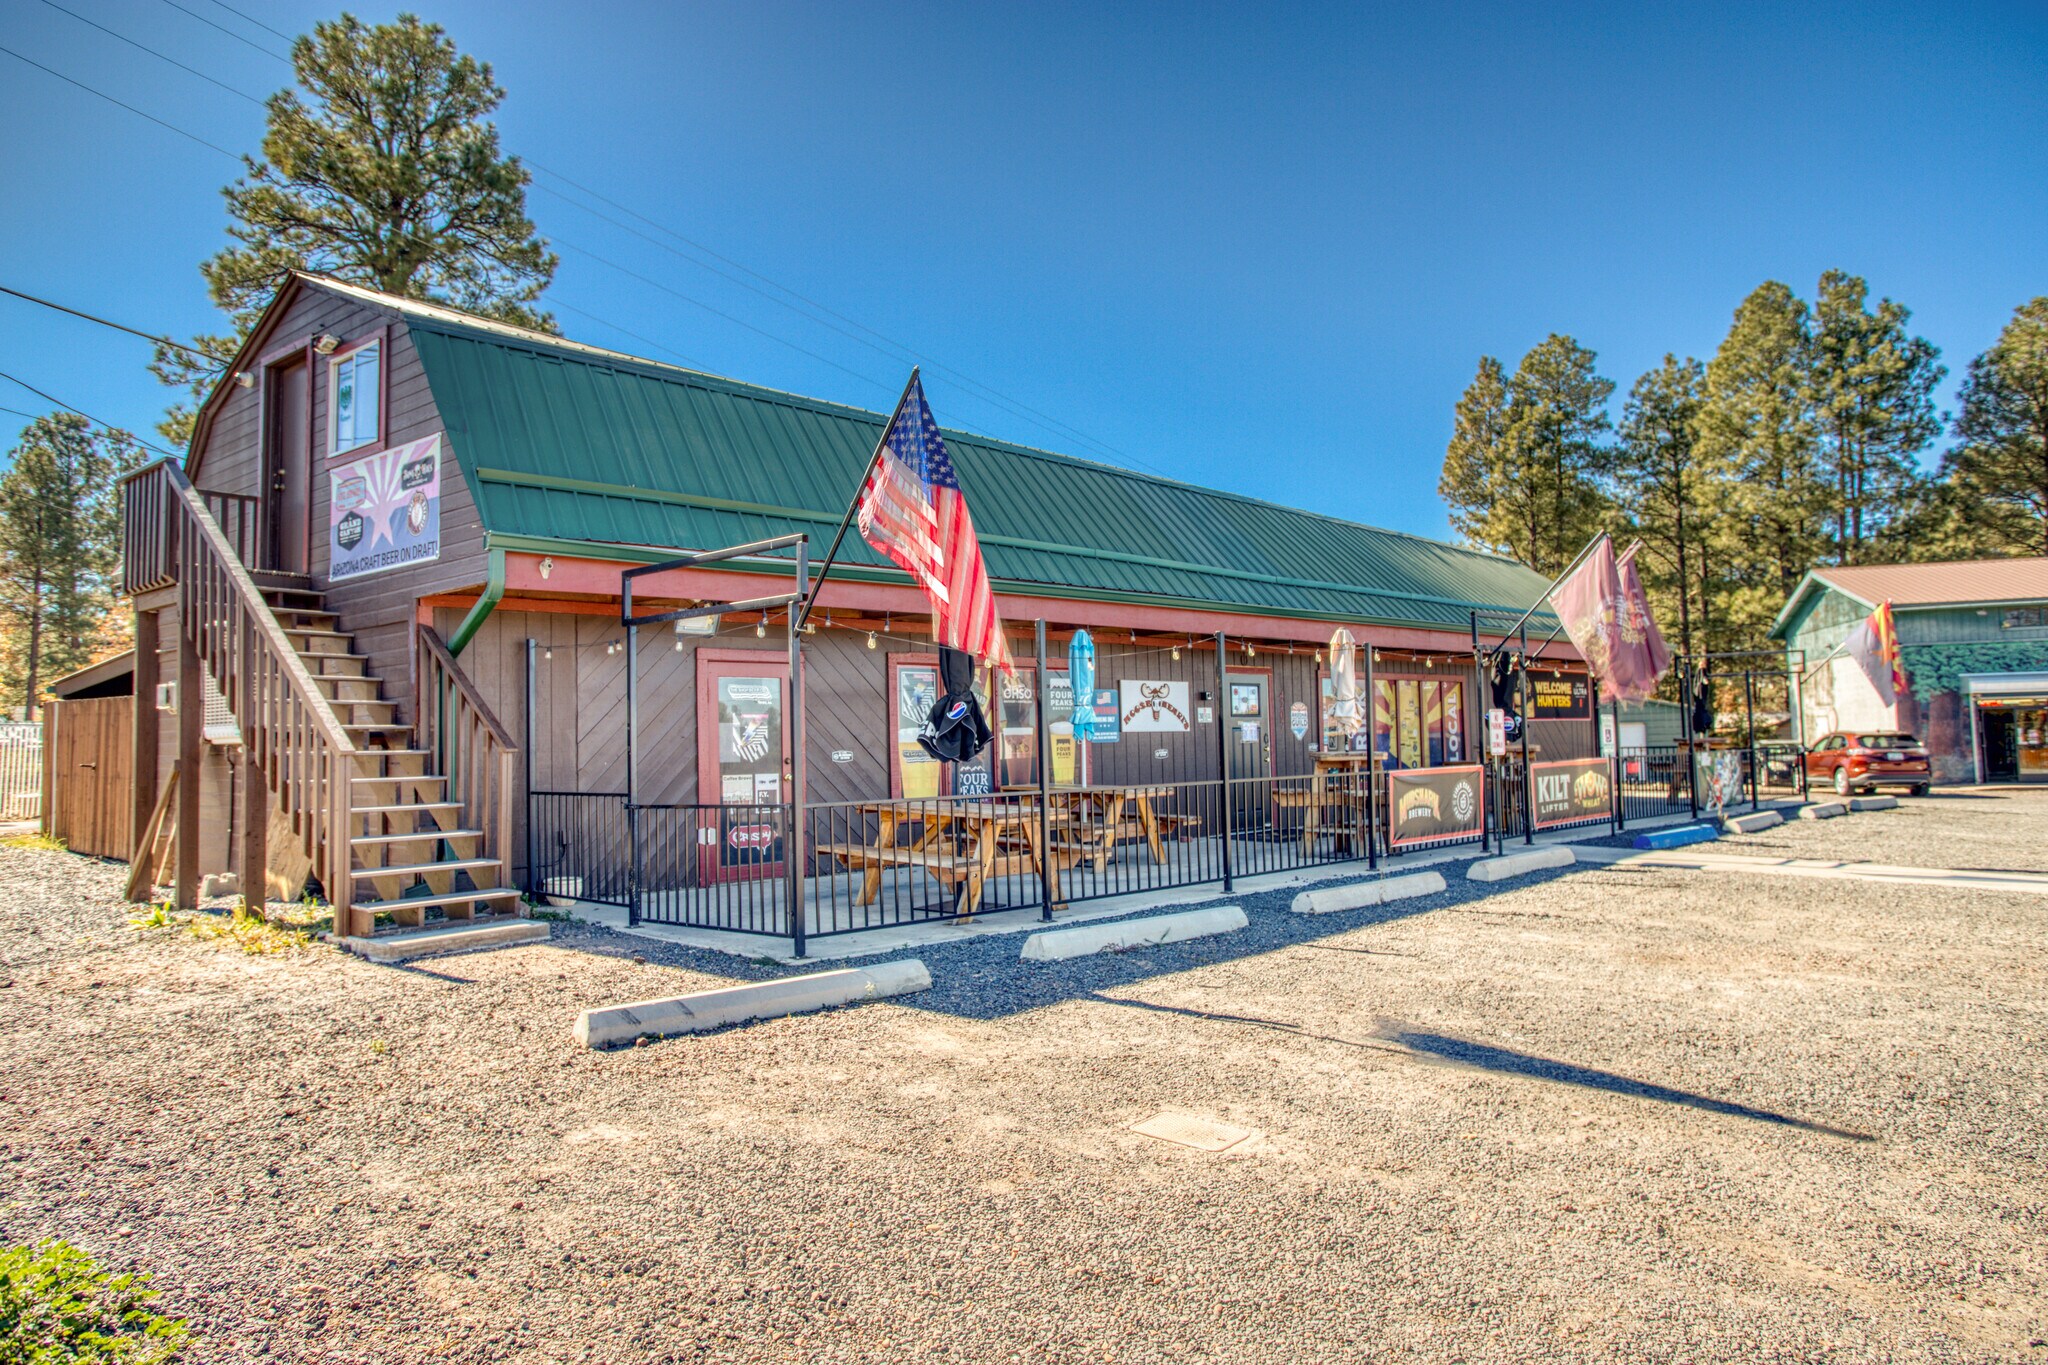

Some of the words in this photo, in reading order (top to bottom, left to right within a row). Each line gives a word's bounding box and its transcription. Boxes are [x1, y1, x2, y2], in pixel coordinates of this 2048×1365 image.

[340, 518, 362, 530] GRAND
[332, 560, 359, 576] ARIZONA
[360, 554, 380, 571] CRAFT
[381, 550, 399, 566] BEER
[401, 547, 411, 561] ON
[1534, 681, 1572, 694] WELCOME
[1573, 688, 1587, 696] ULTRA
[1050, 691, 1073, 699] FOUR
[1536, 694, 1572, 708] HUNTERS
[1124, 700, 1152, 725] MOOSE
[1291, 719, 1308, 727] GUILD
[1447, 693, 1459, 762] LOCAL
[1537, 774, 1571, 803] KILT
[1541, 802, 1569, 814] LIFTER
[1582, 797, 1600, 808] WHEAT
[1408, 807, 1432, 820] BREWERY
